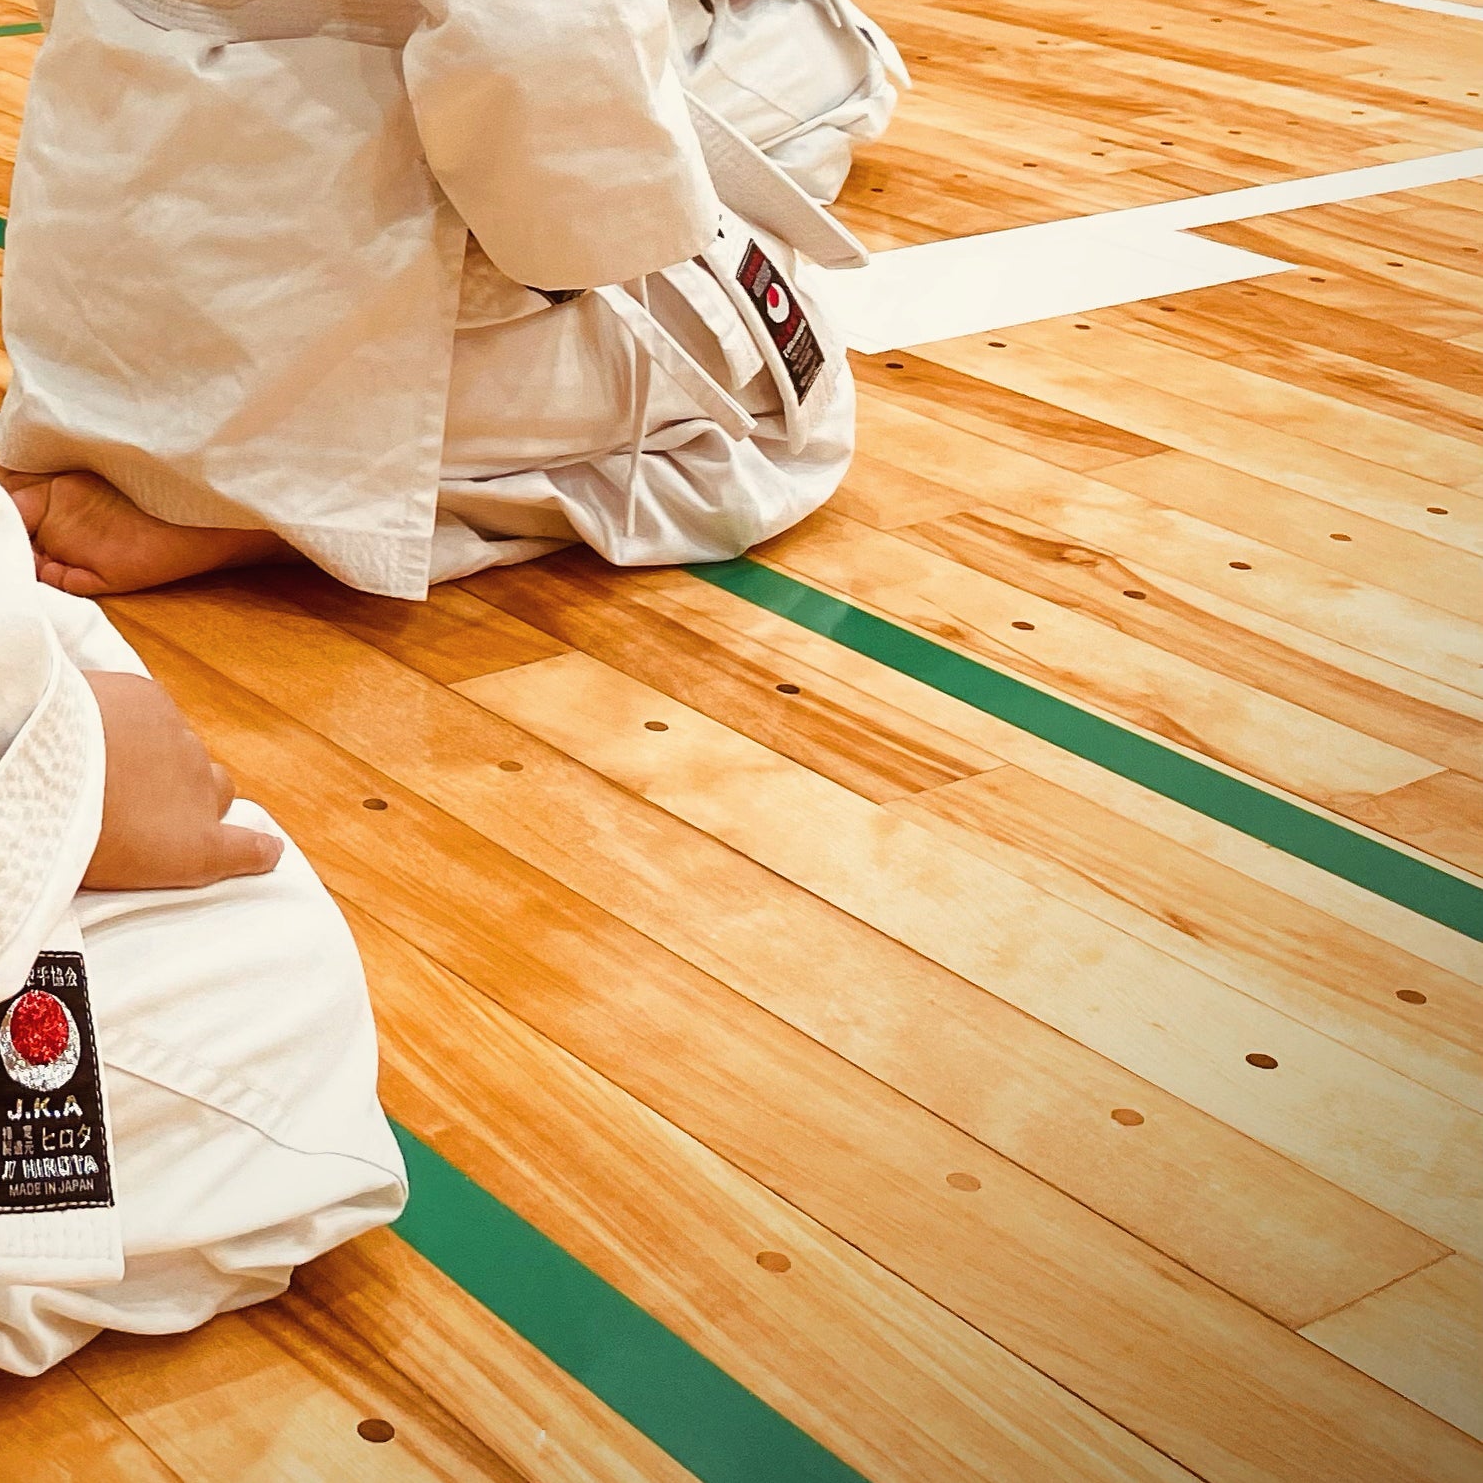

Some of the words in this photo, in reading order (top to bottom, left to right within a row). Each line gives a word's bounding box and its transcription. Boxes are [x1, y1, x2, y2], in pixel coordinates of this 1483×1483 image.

[42, 1123, 91, 1151] ヒロタ
[22, 1155, 98, 1178] HIROTA
[9, 1182, 41, 1197] MADE
[44, 1181, 56, 1195] IN
[58, 1178, 94, 1194] JAPAN
